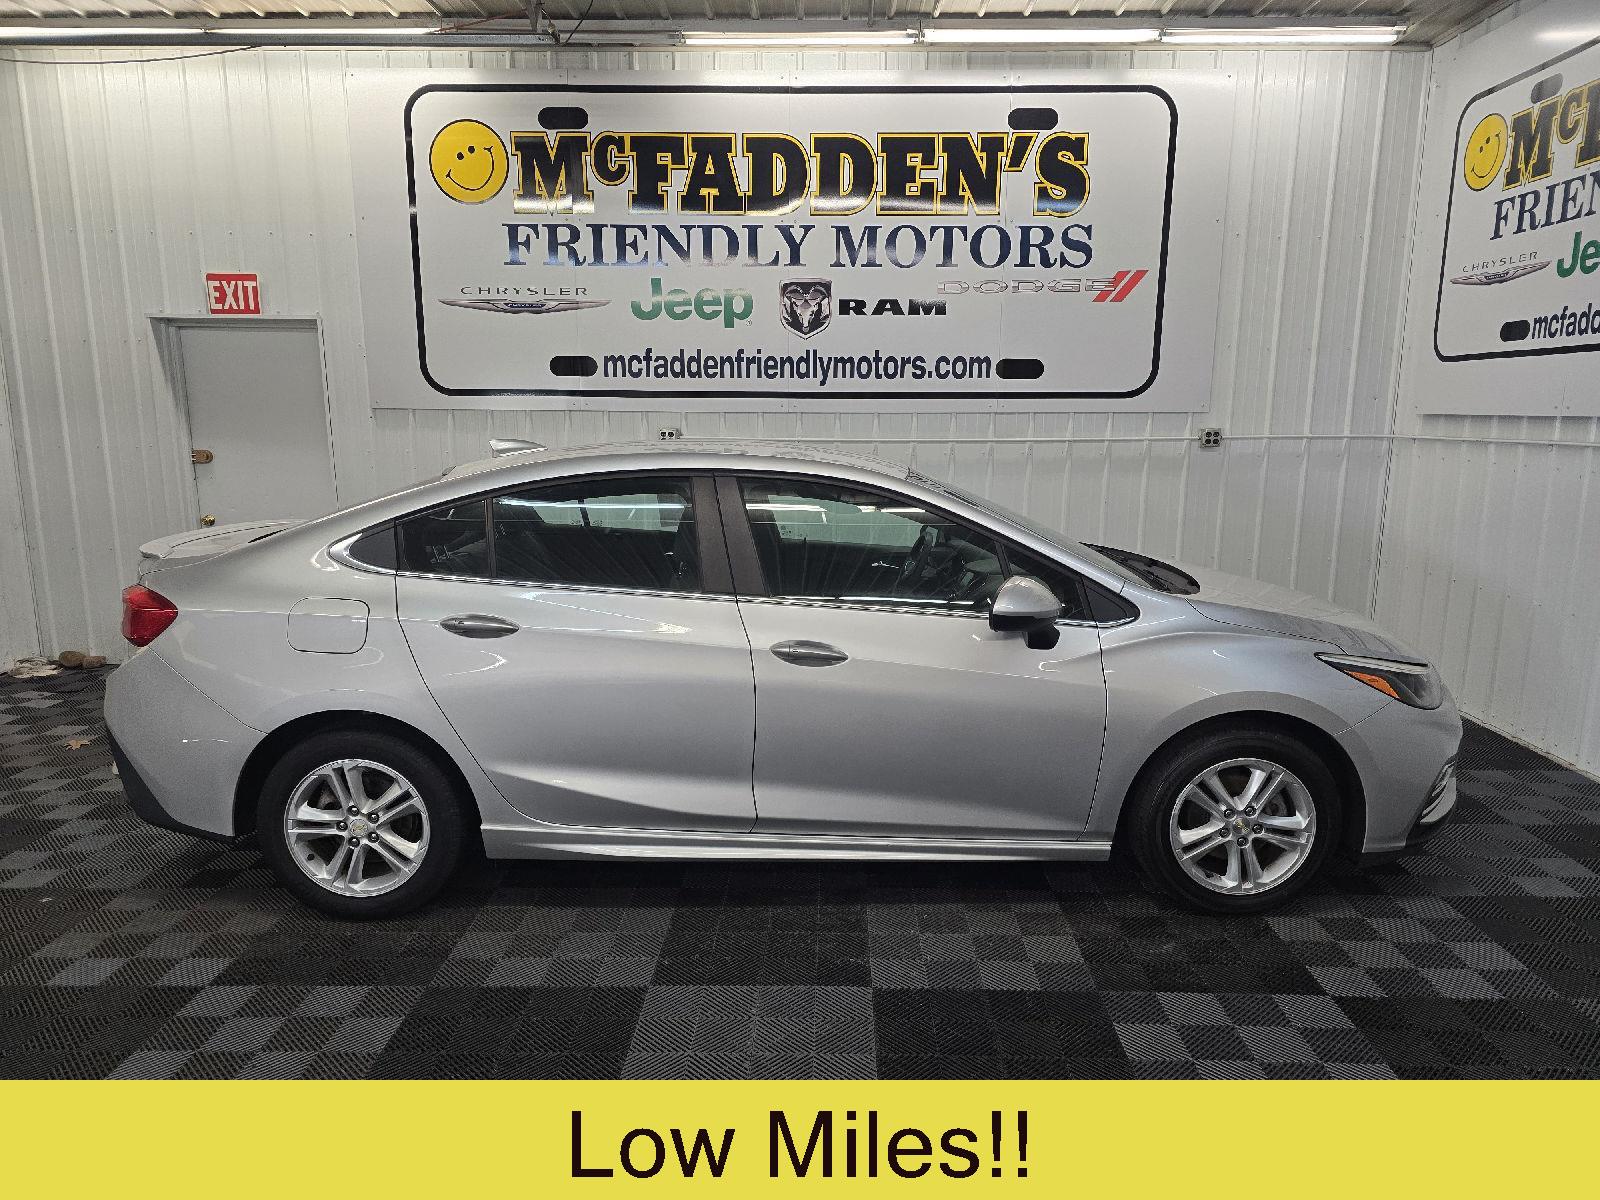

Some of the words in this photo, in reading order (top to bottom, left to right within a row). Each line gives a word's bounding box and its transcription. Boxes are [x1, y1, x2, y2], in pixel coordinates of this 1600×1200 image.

[502, 223, 816, 267] FRIENDLY
[829, 223, 1093, 269] MOTORS
[1462, 251, 1538, 273] CHRYSLER
[207, 280, 257, 311] EXIT
[460, 286, 589, 296] CHRYSLER
[937, 278, 1116, 294] DODGE
[630, 277, 754, 329] Jeep
[838, 298, 947, 316] RAM
[603, 347, 992, 386] mcfaddenfriendlymotors.com
